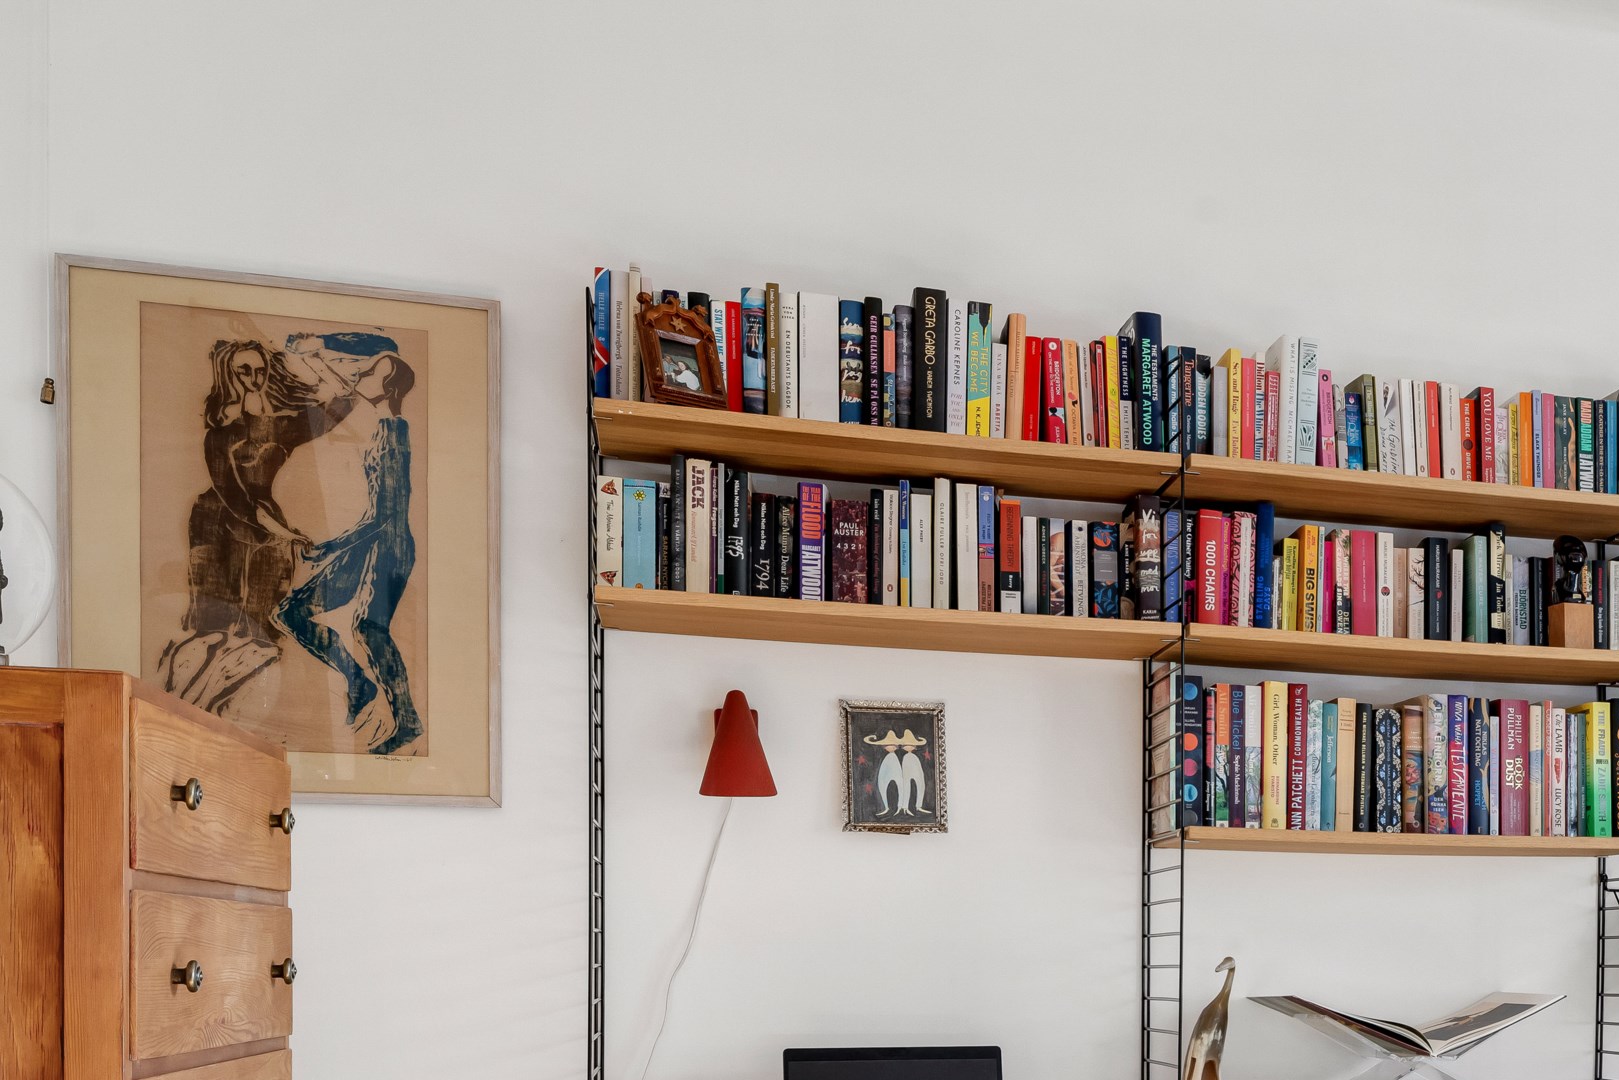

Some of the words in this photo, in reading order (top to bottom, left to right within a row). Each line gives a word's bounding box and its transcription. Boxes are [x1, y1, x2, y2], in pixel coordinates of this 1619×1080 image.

[714, 309, 723, 325] STAY
[870, 316, 879, 332] GEIR
[925, 297, 935, 328] GRETA
[953, 310, 961, 351] CAROLINE
[970, 331, 978, 346] WE
[925, 330, 935, 365] GARBO
[980, 348, 988, 365] THE
[953, 354, 961, 385] KEPNES
[970, 350, 978, 392] BECAME
[1142, 338, 1151, 396] MARGARET
[1256, 362, 1265, 390] Didion
[980, 370, 988, 394] CITY
[1184, 359, 1194, 406] Tangerine
[1256, 392, 1265, 408] The
[1484, 392, 1492, 416] YOU
[1143, 400, 1152, 445] ATWOOD
[1197, 409, 1206, 439] BODIES
[1484, 418, 1492, 443] LOVE
[1485, 446, 1492, 460] ME
[692, 466, 705, 509] JACK
[802, 502, 821, 540] FLOOD
[1142, 509, 1155, 522] Vi
[781, 554, 789, 575] Dear
[1206, 540, 1216, 566] 1000
[755, 559, 770, 590] 1794
[780, 576, 788, 592] Life
[1306, 568, 1314, 590] BIG
[1206, 569, 1216, 610] CHAIRS
[1232, 690, 1242, 714] Blue
[1434, 706, 1442, 732] LENA
[1232, 719, 1242, 750] Ticket
[1434, 734, 1442, 781] EINHORN
[1292, 759, 1303, 809] PATCHETT
[1506, 760, 1514, 788] DUST
[1515, 757, 1523, 790] BOOK
[1292, 811, 1302, 830] ANN
